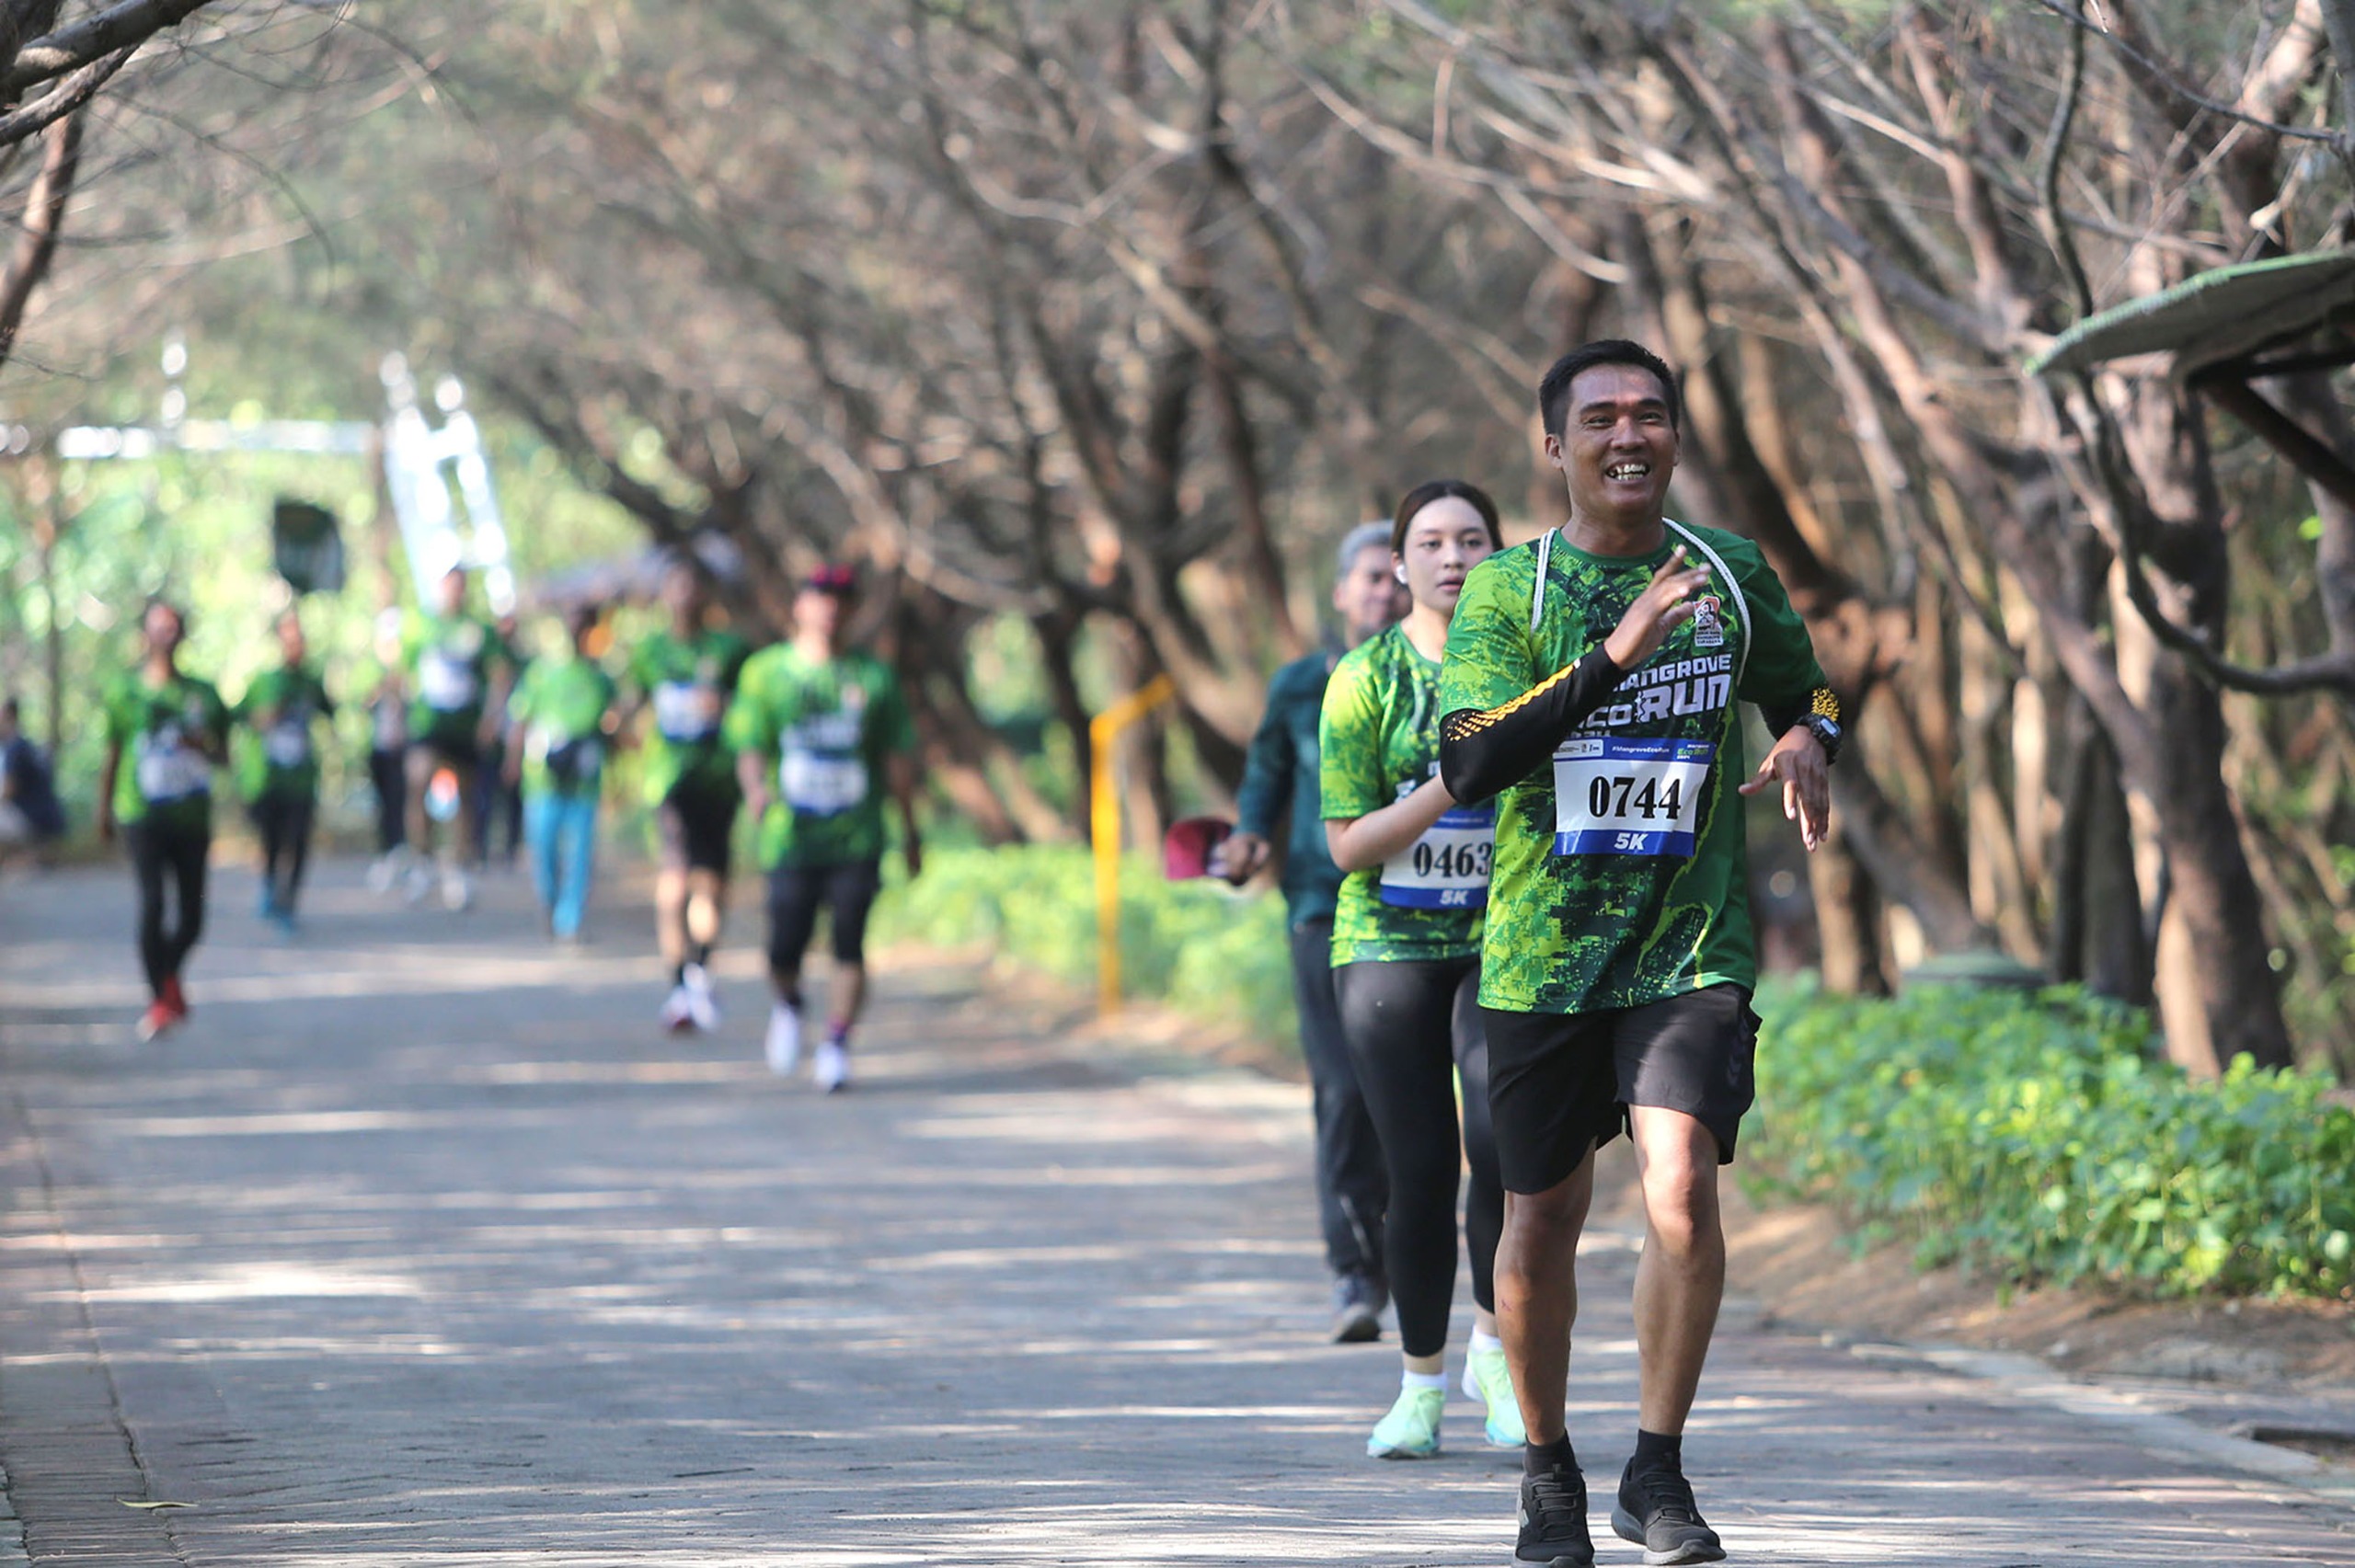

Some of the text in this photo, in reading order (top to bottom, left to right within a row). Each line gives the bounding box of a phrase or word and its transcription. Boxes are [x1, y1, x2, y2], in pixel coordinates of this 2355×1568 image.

[1614, 654, 1732, 692] ANGROVE
[1578, 673, 1731, 729] CO RUN
[1589, 776, 1682, 819] 0744
[1413, 841, 1492, 878] 0463
[1614, 832, 1648, 851] 5K
[1439, 889, 1468, 906] 5K
